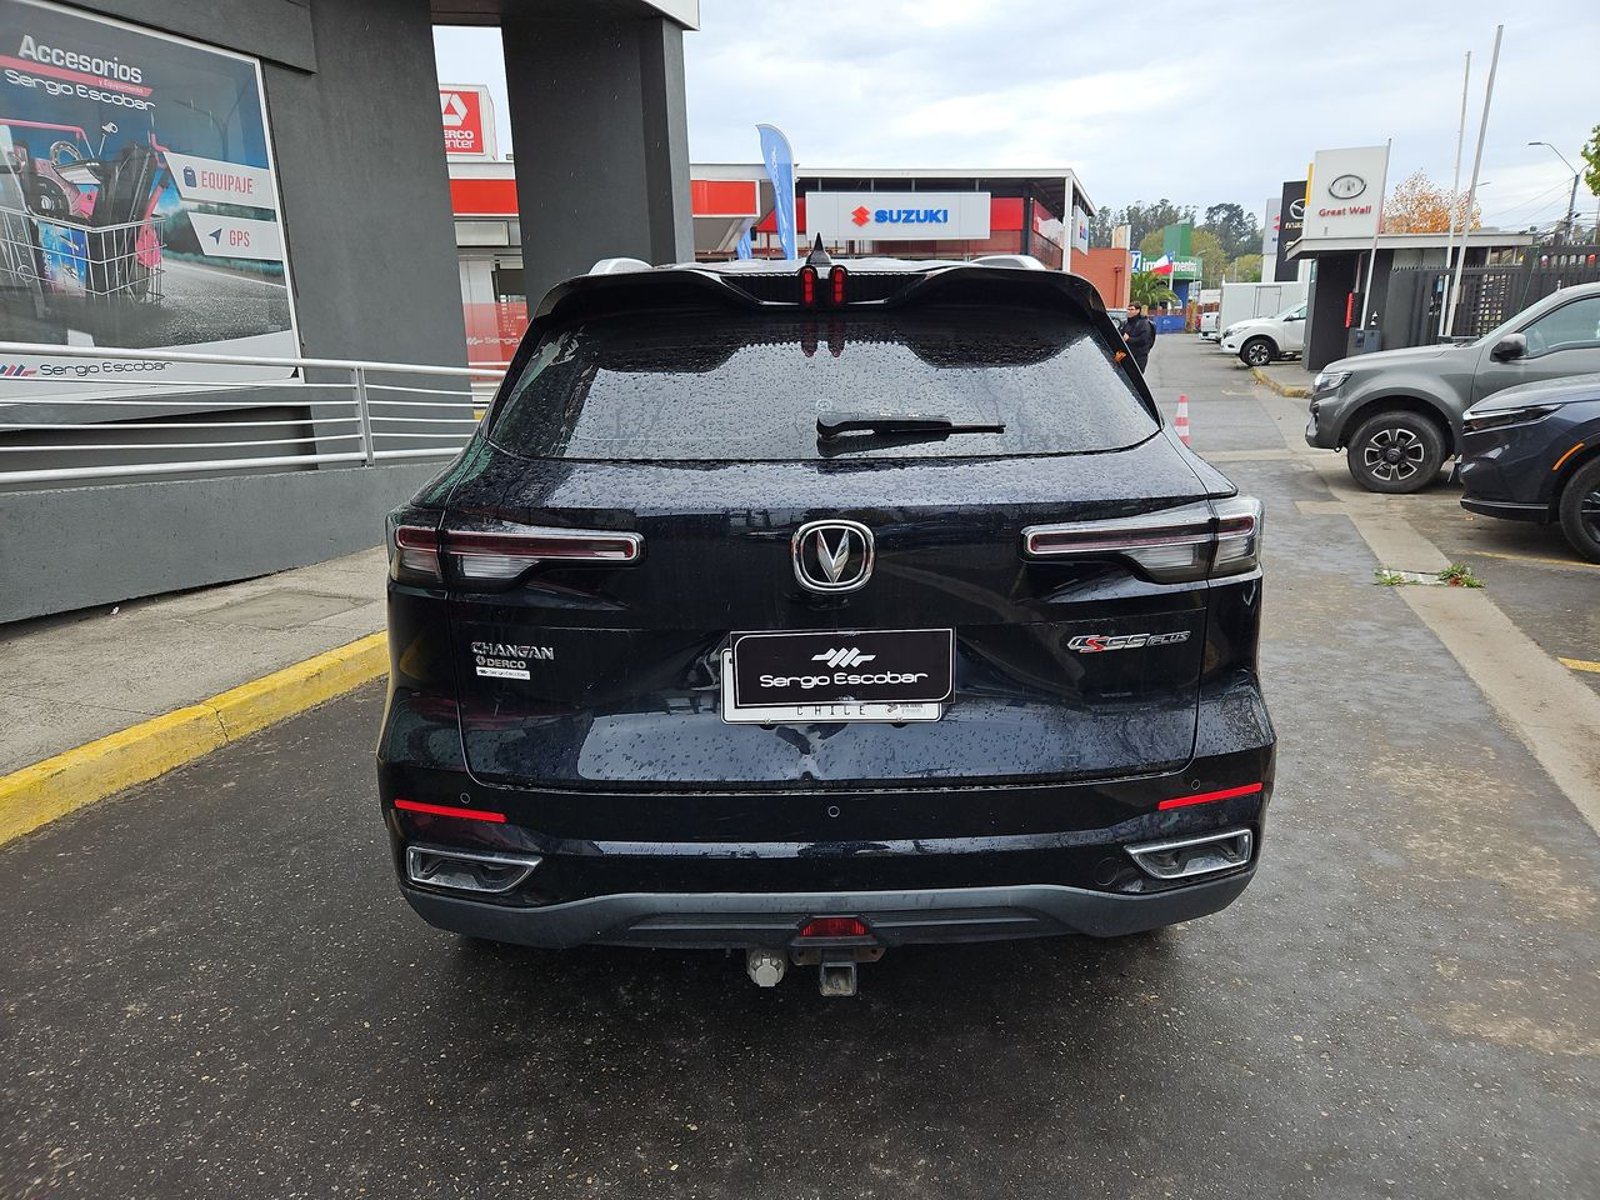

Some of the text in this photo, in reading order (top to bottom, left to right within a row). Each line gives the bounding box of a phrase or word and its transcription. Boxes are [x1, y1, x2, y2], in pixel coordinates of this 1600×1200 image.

[18, 34, 142, 84] Accesorios
[4, 69, 74, 96] Sergio
[76, 83, 156, 111] Escobar
[444, 129, 475, 140] ERCO
[201, 170, 253, 194] EQUIPAJE
[874, 209, 948, 223] SUZUKI
[1318, 205, 1372, 217] Great Wall
[229, 229, 250, 247] GPS
[40, 361, 173, 376] Sergio Escobar
[1146, 630, 1191, 646] PLUS
[471, 641, 554, 660] CHANGAN
[487, 658, 527, 669] DERCO
[760, 671, 929, 689] Sergio Escobar
[796, 704, 866, 716] CHILE
